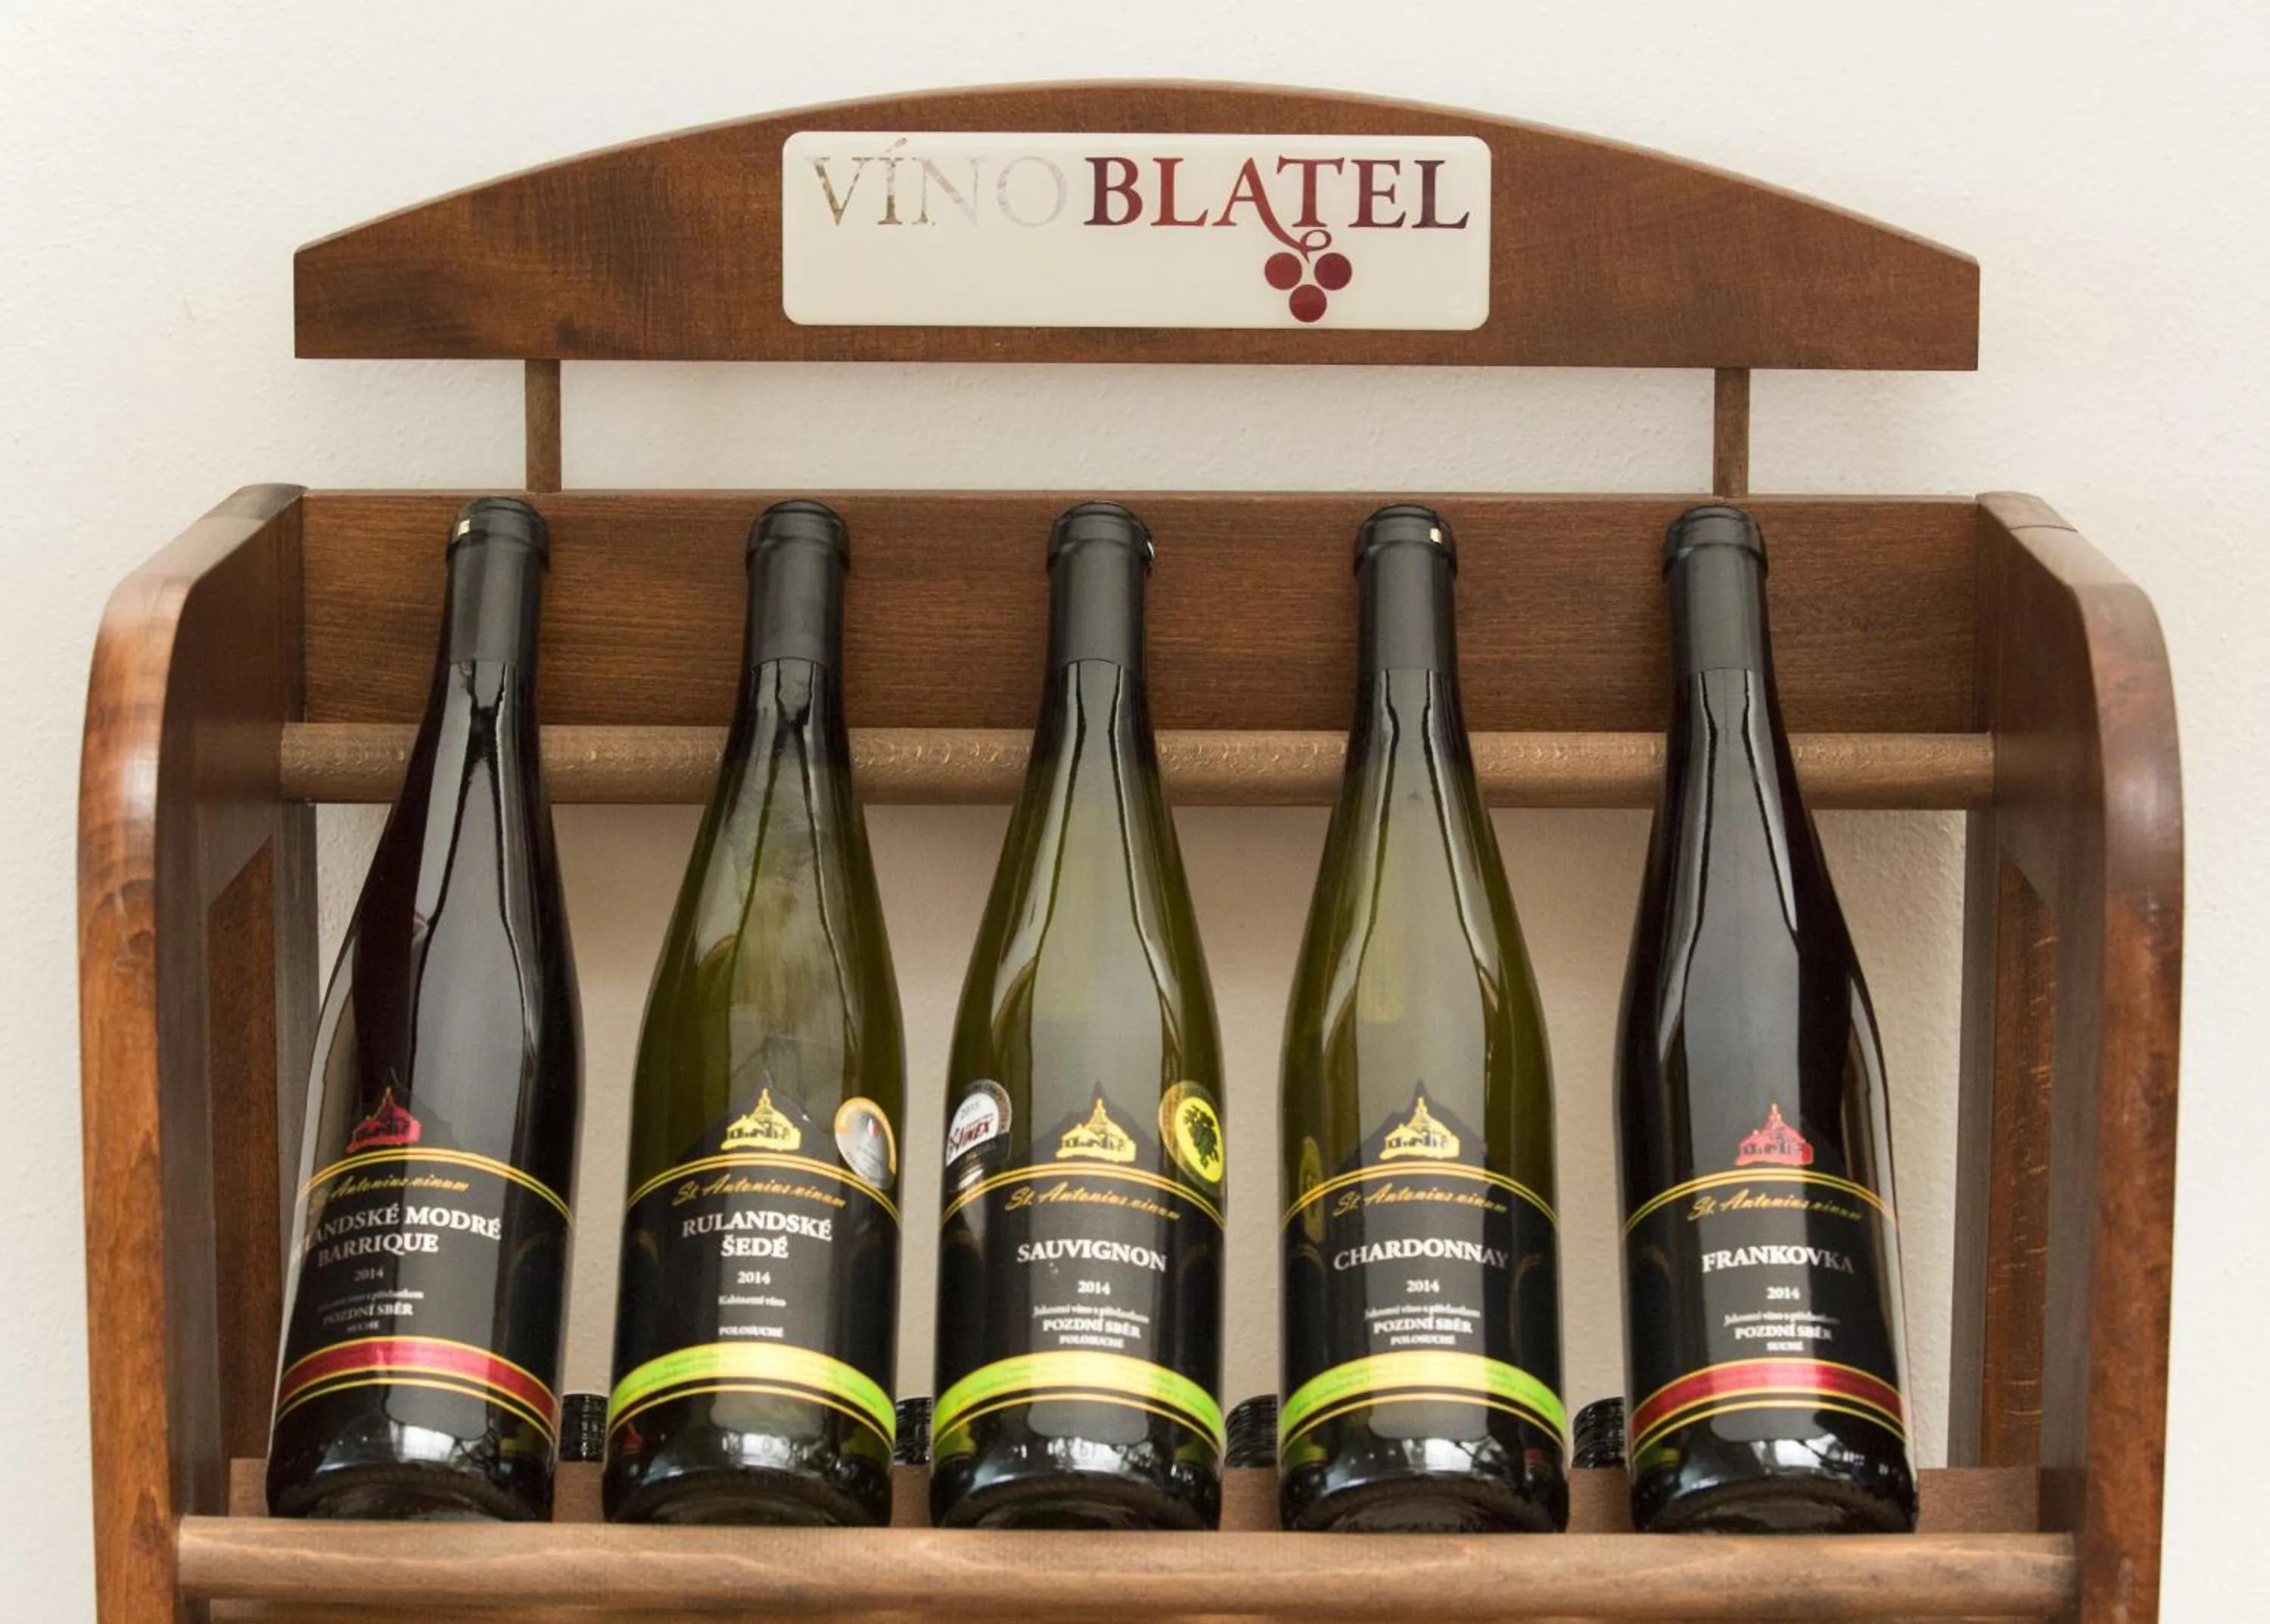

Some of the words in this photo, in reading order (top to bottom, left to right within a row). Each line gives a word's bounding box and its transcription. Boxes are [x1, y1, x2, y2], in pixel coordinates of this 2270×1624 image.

[805, 137, 1068, 228] VÍNO
[1084, 154, 1470, 257] BLATEL
[403, 1206, 502, 1241] MODRÉ
[682, 1210, 832, 1243] RULANDSKÉ
[317, 1232, 440, 1268] BARRIQUE
[720, 1234, 789, 1259] ŠEDÉ
[1016, 1238, 1168, 1272] SAUVIGNON
[1332, 1237, 1510, 1271] CHARDONNAY
[1702, 1244, 1855, 1275] FRANKOVKA
[353, 1267, 385, 1282] 2014
[737, 1271, 772, 1285] 2014
[1077, 1280, 1112, 1296] 2014
[1406, 1280, 1441, 1293] 2014
[1766, 1286, 1801, 1300] 2014
